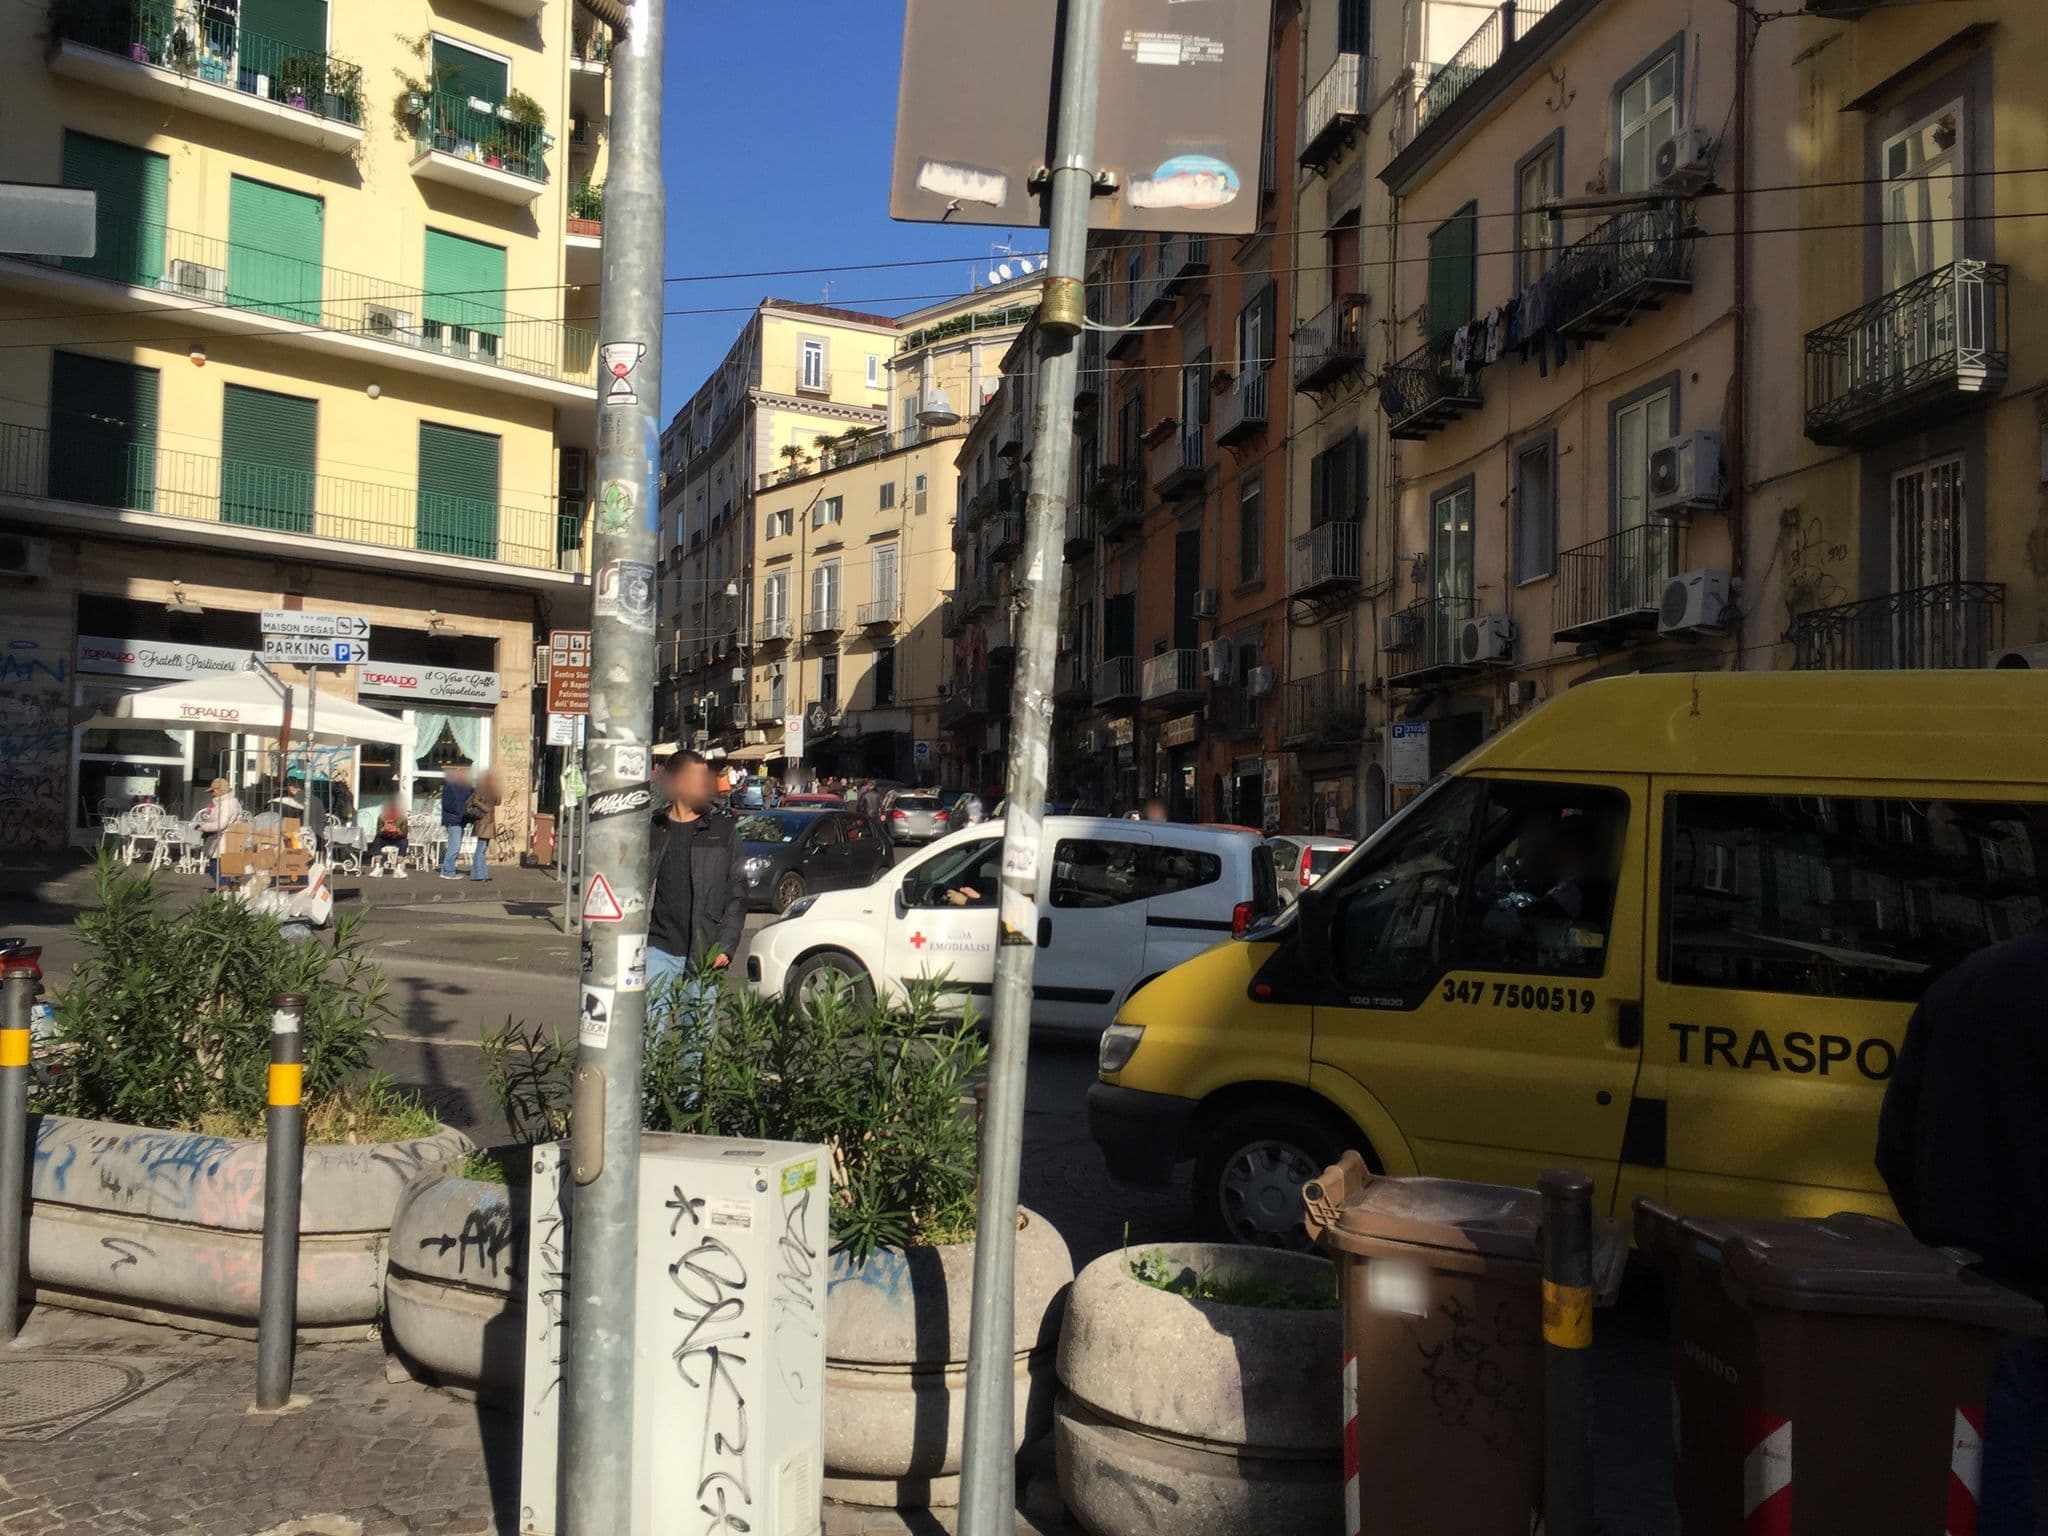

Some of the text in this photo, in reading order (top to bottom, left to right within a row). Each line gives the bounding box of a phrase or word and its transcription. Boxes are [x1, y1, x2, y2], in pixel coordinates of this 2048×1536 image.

[263, 623, 335, 635] MAISON DEGAS
[266, 641, 330, 656] PARKING
[82, 649, 136, 664] TORALDO
[138, 649, 184, 669] Fratelli
[362, 672, 418, 687] TORALDO
[554, 670, 575, 679] Centro
[429, 684, 487, 698] Napoletano
[558, 690, 590, 699] Patrimoni
[180, 705, 240, 721] TORALDO
[1442, 979, 1596, 1014] 347 7500519
[1668, 1023, 1898, 1080] TRASPO
